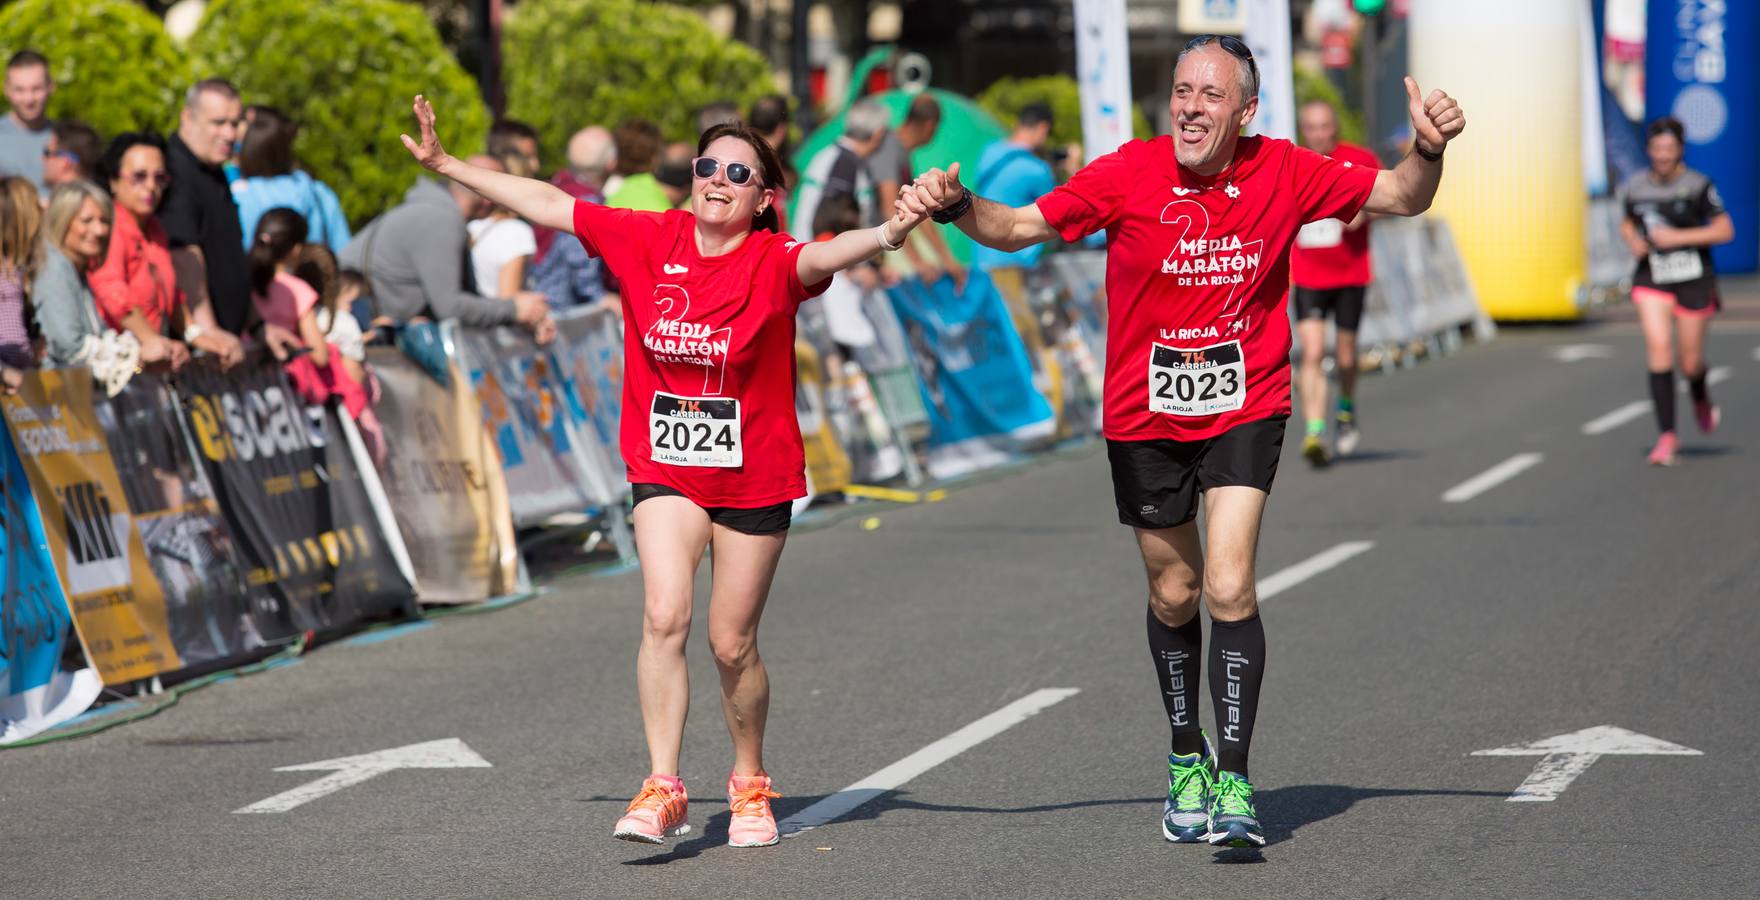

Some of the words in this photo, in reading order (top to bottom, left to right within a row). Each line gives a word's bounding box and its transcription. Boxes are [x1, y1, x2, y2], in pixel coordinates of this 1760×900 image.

[1180, 234, 1242, 255] MEDIA
[1162, 251, 1259, 274] MARATÓN
[1178, 277, 1192, 286] DE
[1195, 276, 1208, 286] LA
[1211, 274, 1244, 286] RIOJA
[656, 319, 711, 339] MEDIA
[1178, 326, 1219, 340] RIOJA
[644, 333, 728, 356] MARATÓN
[654, 354, 667, 363] DE
[683, 357, 715, 367] RIOJA
[1172, 360, 1219, 370] CARRERA
[1181, 351, 1207, 365] 7K
[1154, 368, 1239, 402] 2023
[677, 400, 701, 413] 7K
[670, 409, 713, 419] CARRERA
[654, 419, 736, 452] 2024
